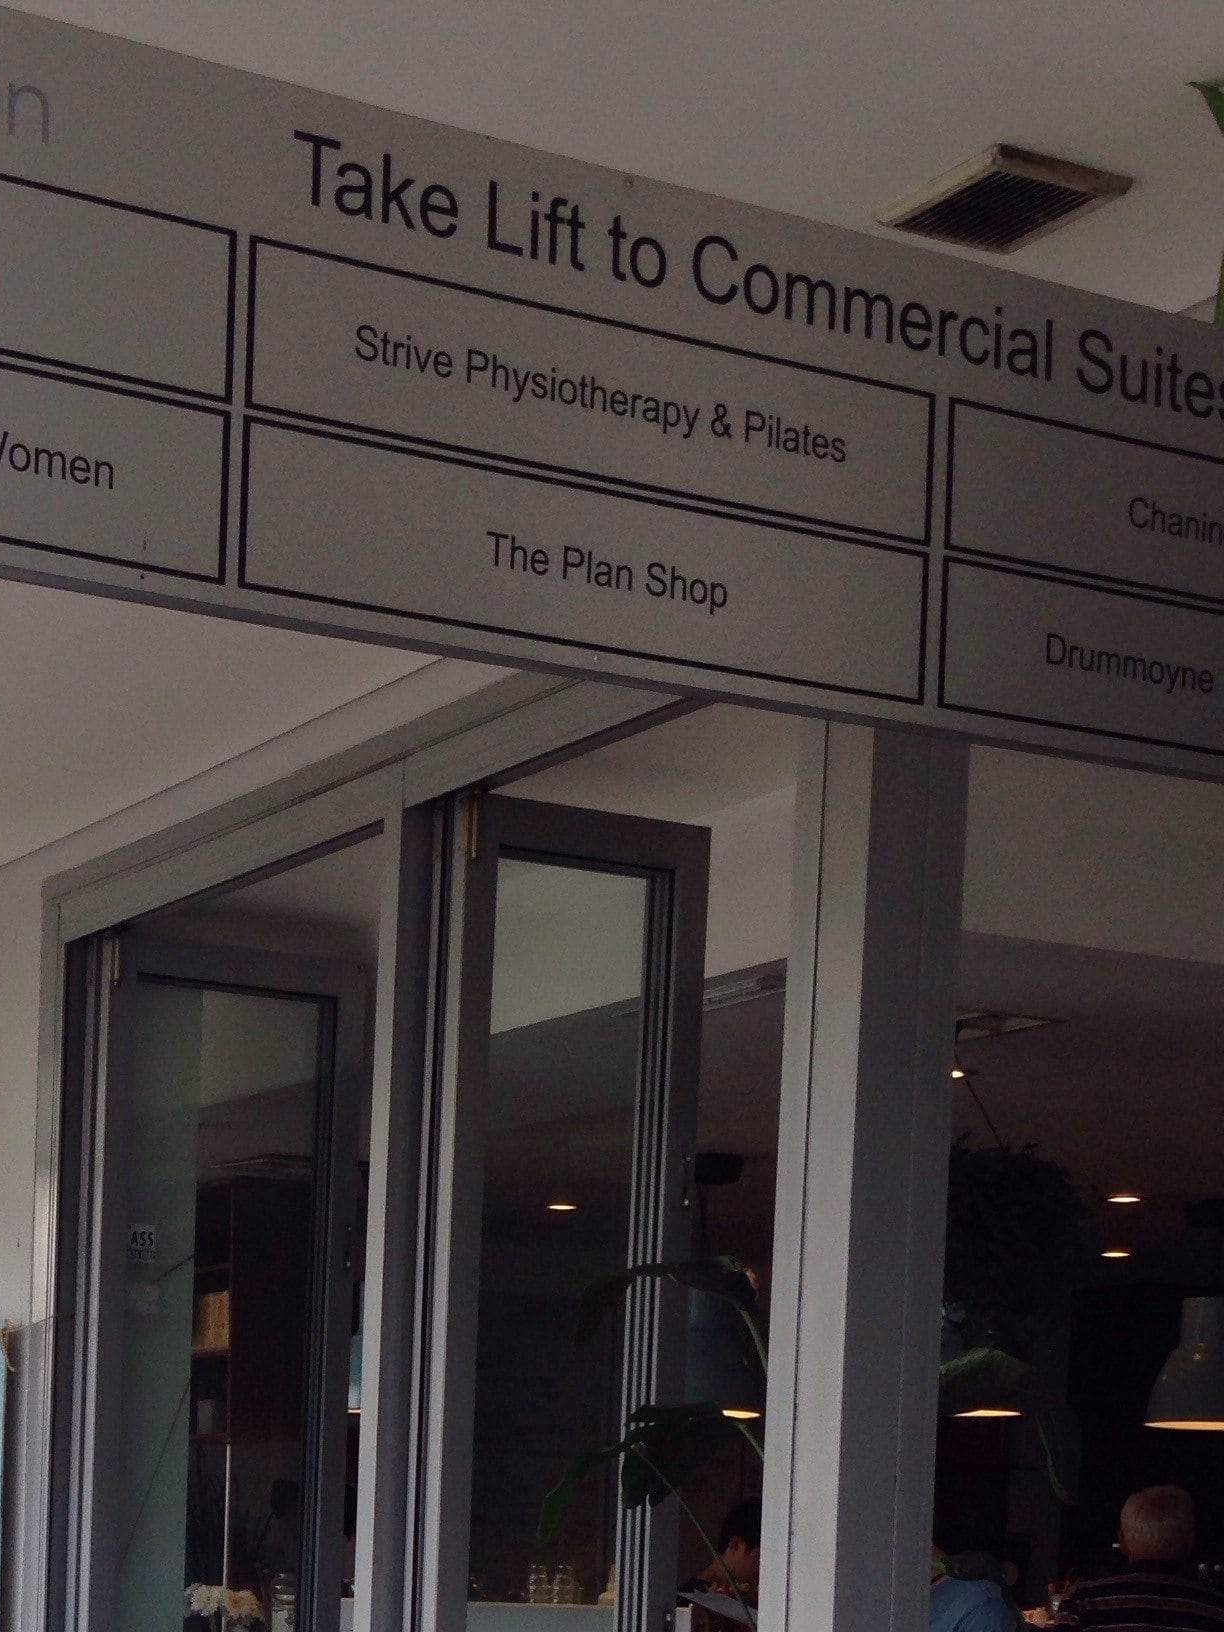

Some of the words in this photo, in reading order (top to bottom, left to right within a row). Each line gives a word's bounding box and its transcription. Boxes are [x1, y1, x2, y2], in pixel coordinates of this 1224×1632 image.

[293, 129, 459, 240] Take
[487, 179, 586, 273] Lift
[607, 214, 668, 290] to
[691, 233, 1054, 383] Commercial
[1076, 328, 1224, 421] Suite
[353, 323, 454, 379] Strive
[465, 347, 701, 440] Physiotherapy
[709, 402, 733, 440] &
[744, 409, 848, 464] Pilates
[486, 529, 550, 577] The
[562, 544, 634, 592] Plan
[644, 561, 729, 616] Shop
[1045, 631, 1215, 695] Drummoyne
